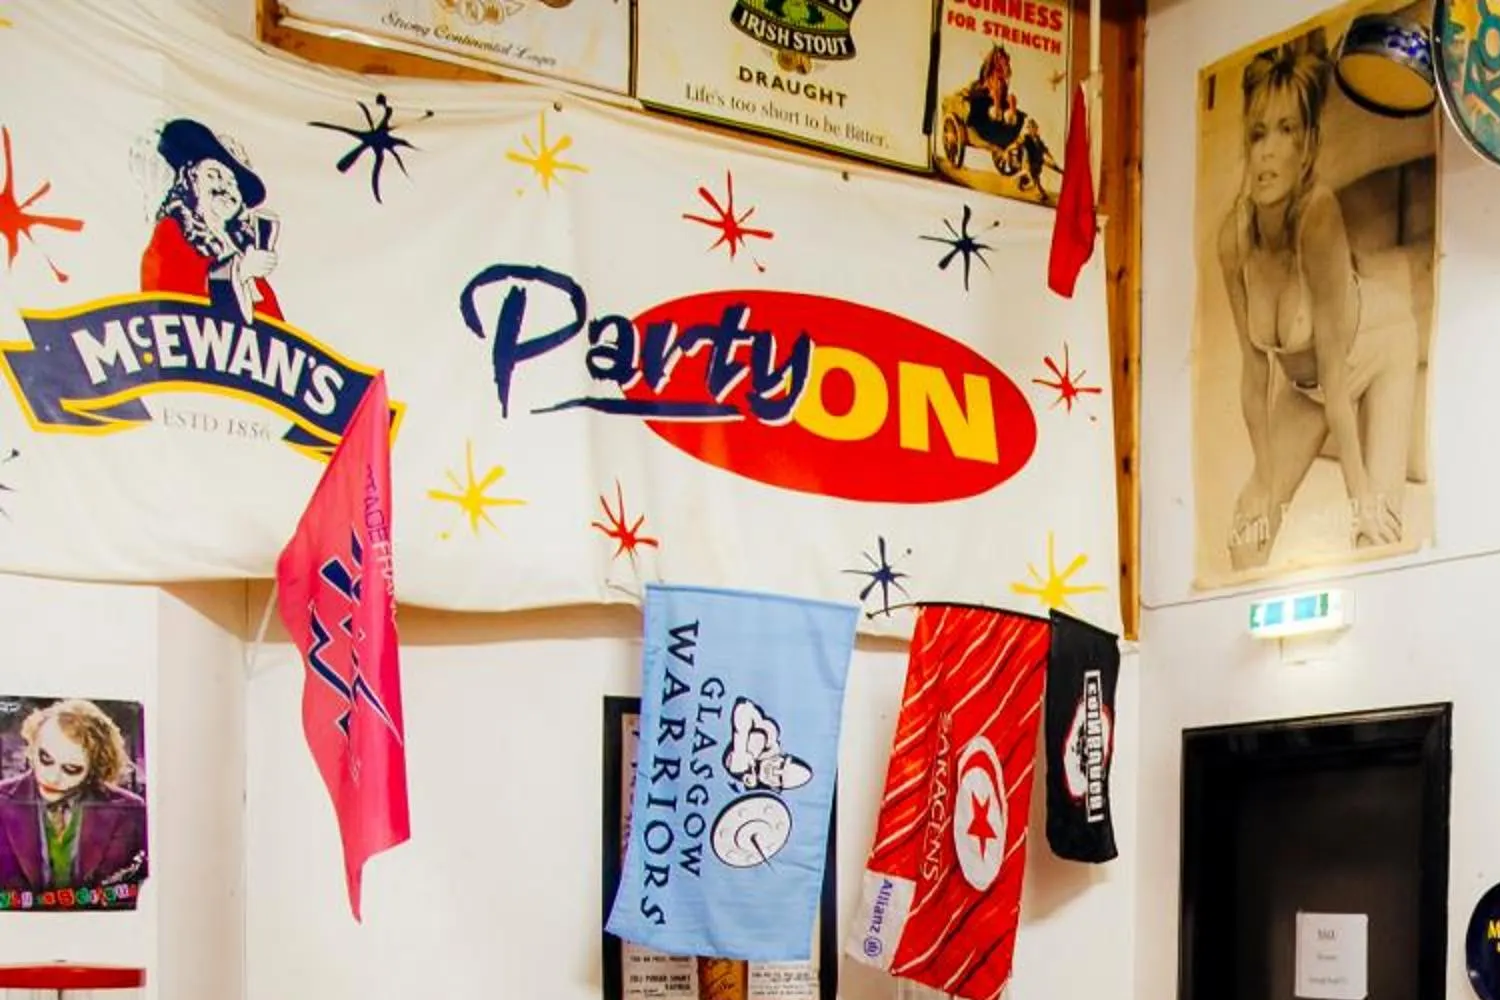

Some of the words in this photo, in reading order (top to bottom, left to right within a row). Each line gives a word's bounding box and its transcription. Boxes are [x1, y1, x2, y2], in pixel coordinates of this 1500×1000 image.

[740, 9, 790, 47] IRISH
[793, 32, 849, 55] STOUT
[947, 10, 976, 31] FOR
[982, 20, 1061, 55] STRENGTH
[685, 83, 726, 106] Life's
[731, 95, 757, 115] too
[761, 101, 801, 126] short
[804, 113, 820, 131] to
[823, 116, 841, 134] be
[738, 65, 848, 109] DRAUGHT
[459, 264, 816, 425] Party
[792, 345, 999, 465] ON
[641, 619, 700, 926] WARRIORS
[678, 676, 725, 878] GLASGOW
[920, 711, 951, 884] SARACENS
[868, 879, 895, 935] Allianz
